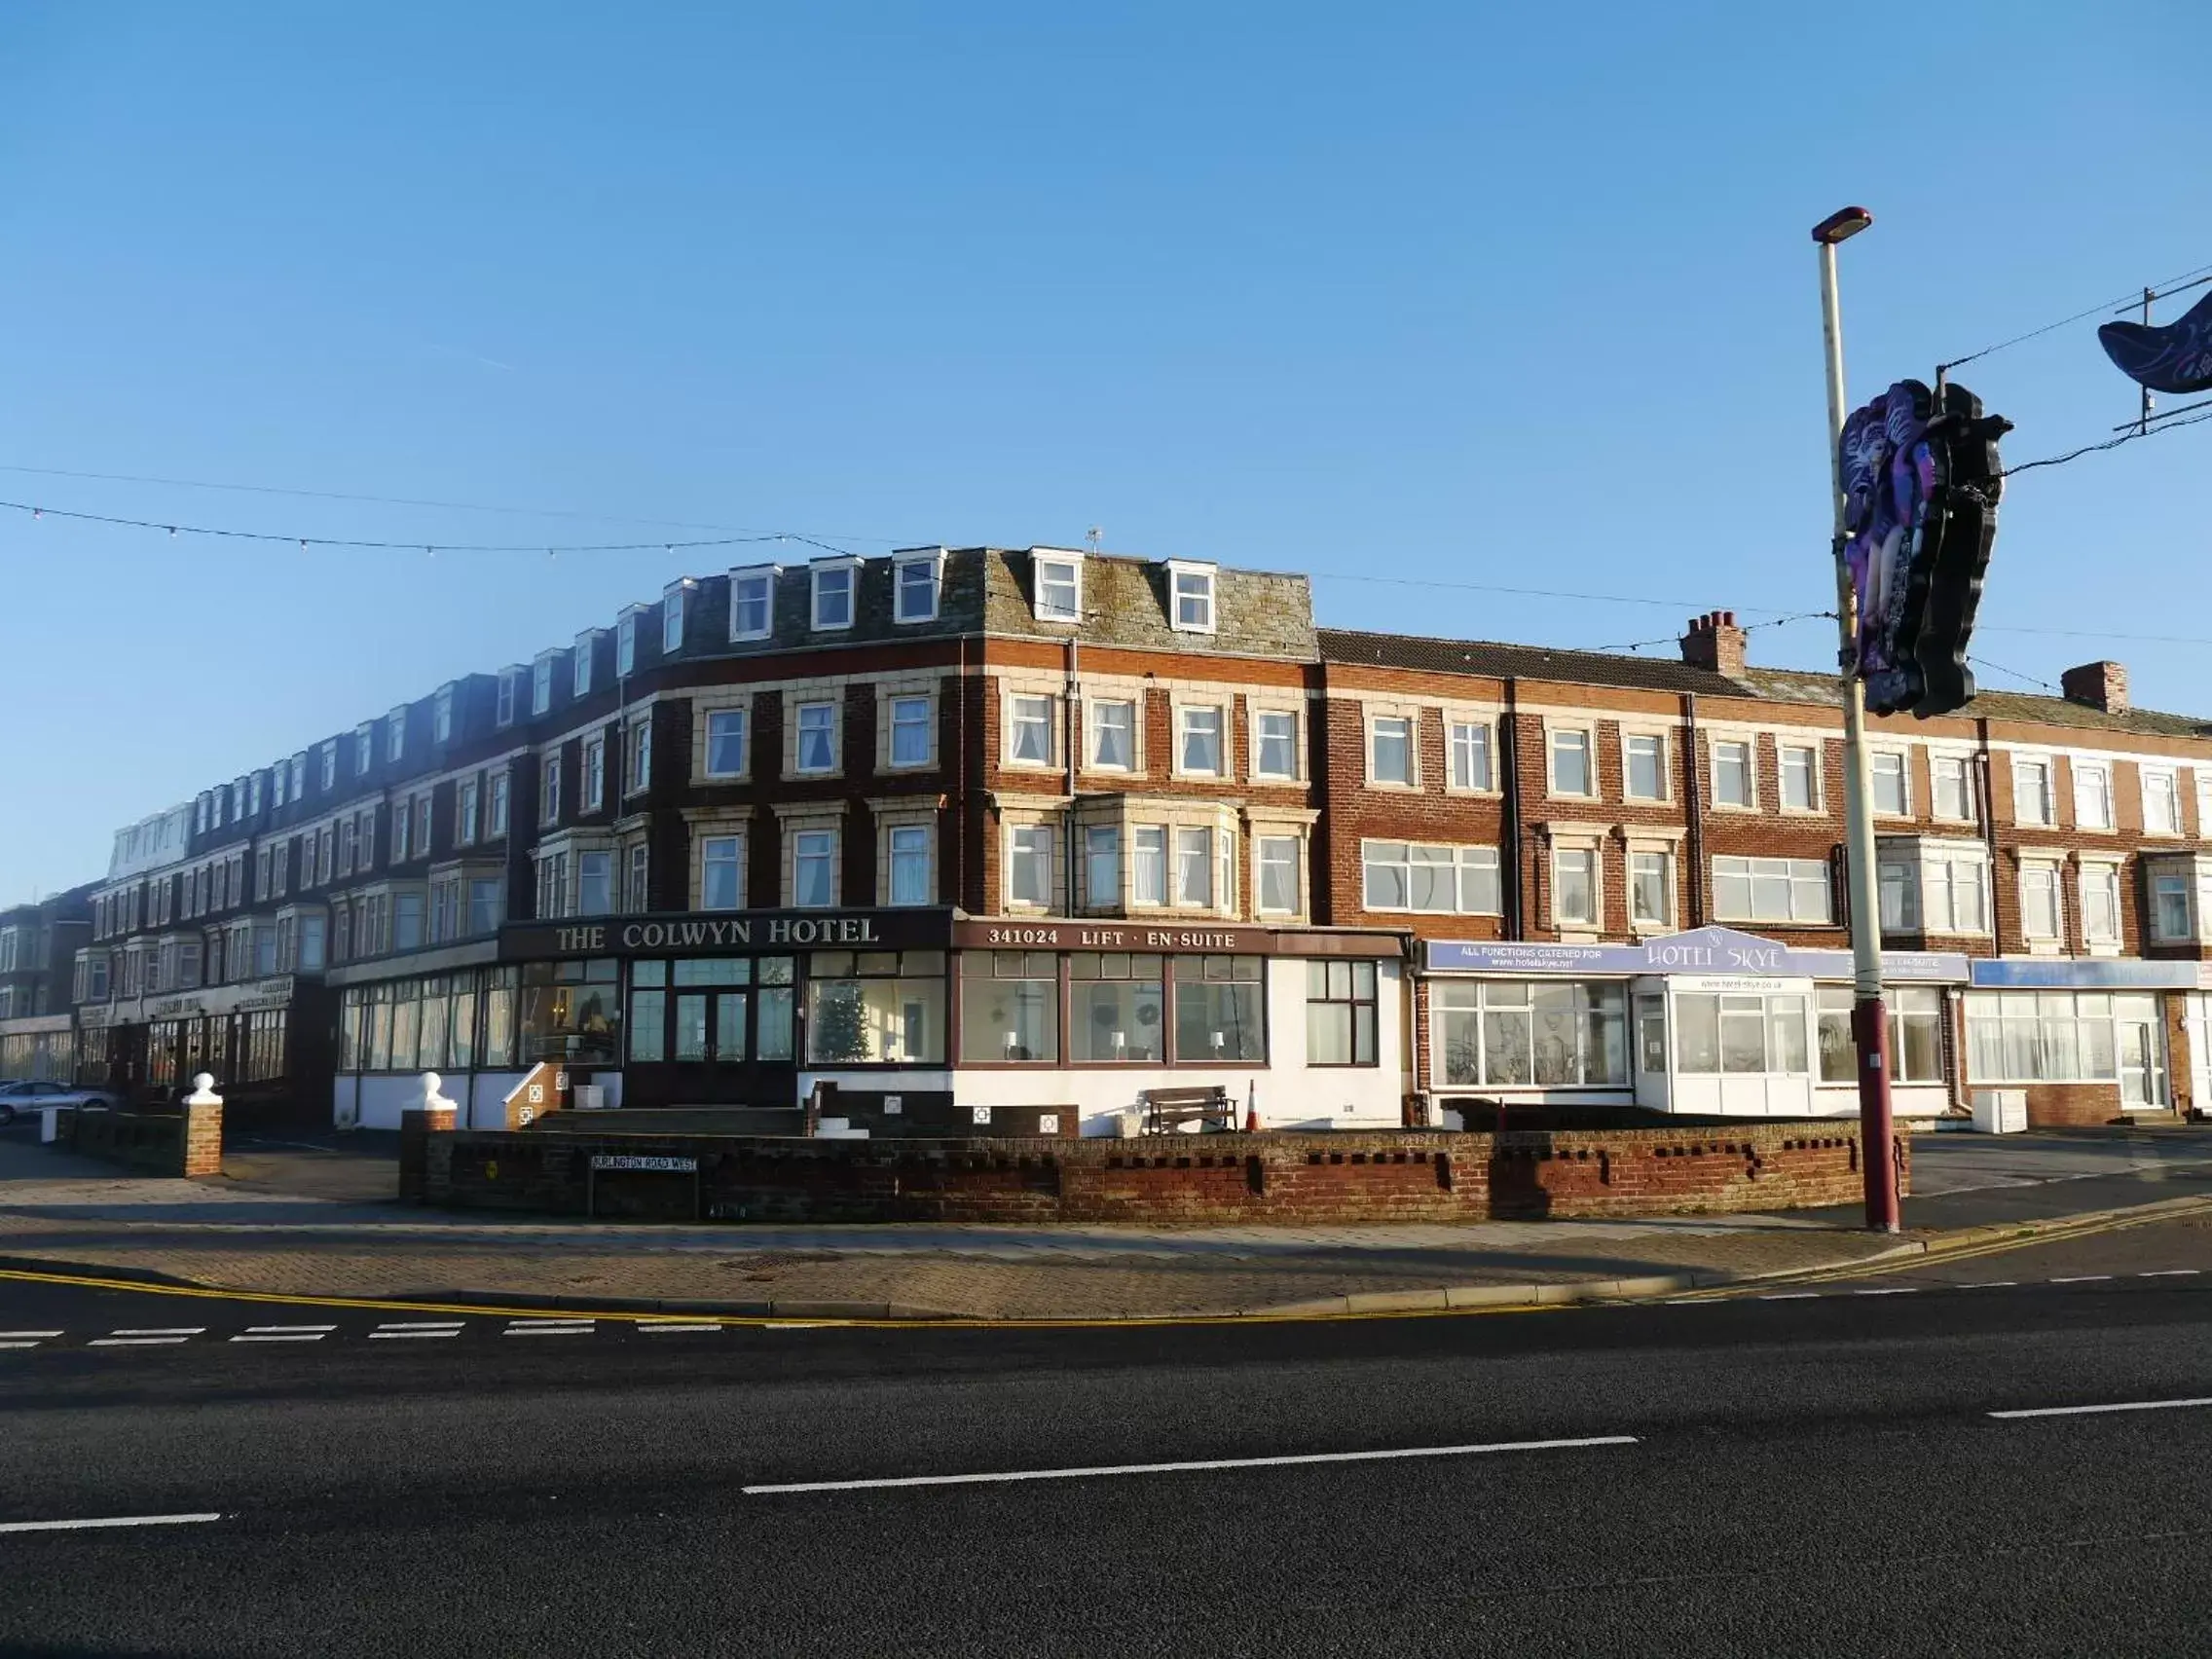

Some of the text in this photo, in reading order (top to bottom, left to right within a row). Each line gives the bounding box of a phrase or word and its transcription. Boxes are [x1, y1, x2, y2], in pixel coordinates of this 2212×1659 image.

[557, 918, 879, 950] THE COLWYN HOTEL
[988, 929, 1058, 943] 341024
[1082, 931, 1124, 945] LIFT
[1460, 945, 1603, 960] ALL FUNCTIONS CATERED FOR
[1647, 945, 1783, 973] HOTEL SKYE
[646, 1157, 670, 1169] ROAD
[671, 1158, 697, 1170] WEST
